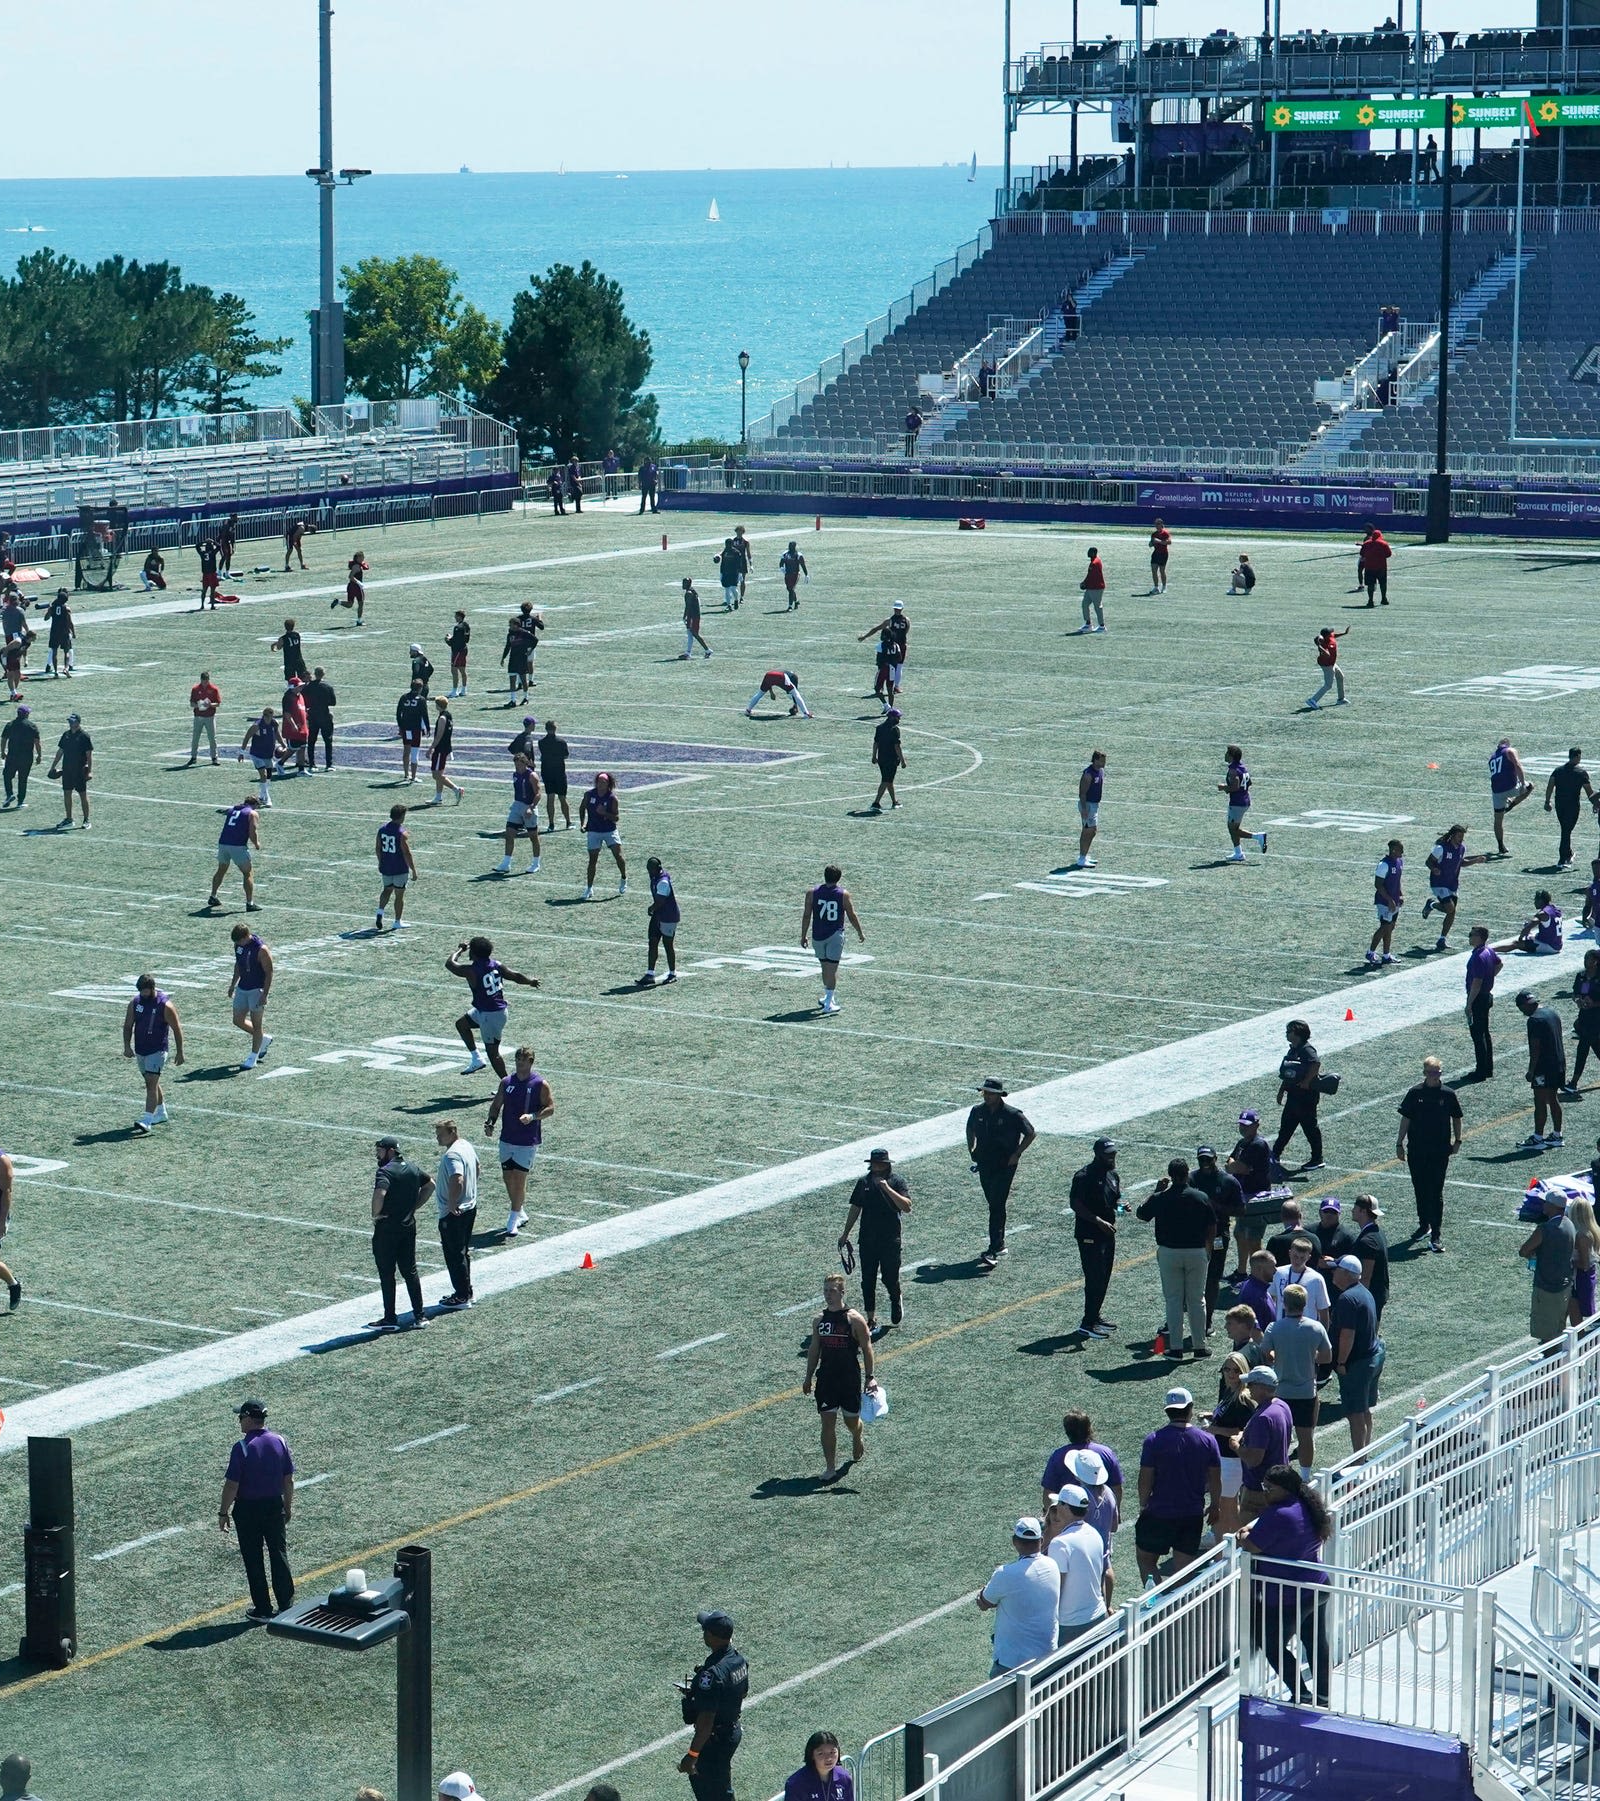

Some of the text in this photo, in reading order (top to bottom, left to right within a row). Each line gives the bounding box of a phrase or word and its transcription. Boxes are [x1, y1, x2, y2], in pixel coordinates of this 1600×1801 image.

[1294, 110, 1340, 121] SUNBELT
[1378, 109, 1425, 120] SUNBELT
[1468, 107, 1517, 118] SUNBELT
[1154, 493, 1196, 502] Constellation
[1263, 494, 1310, 505] UNITED
[1551, 503, 1584, 515] meijer
[204, 552, 210, 561] 3
[56, 606, 62, 616] 0
[1490, 756, 1503, 776] 97
[228, 810, 241, 826] 2
[381, 833, 397, 854] 33
[817, 899, 838, 923] 78
[818, 1322, 832, 1335] 23
